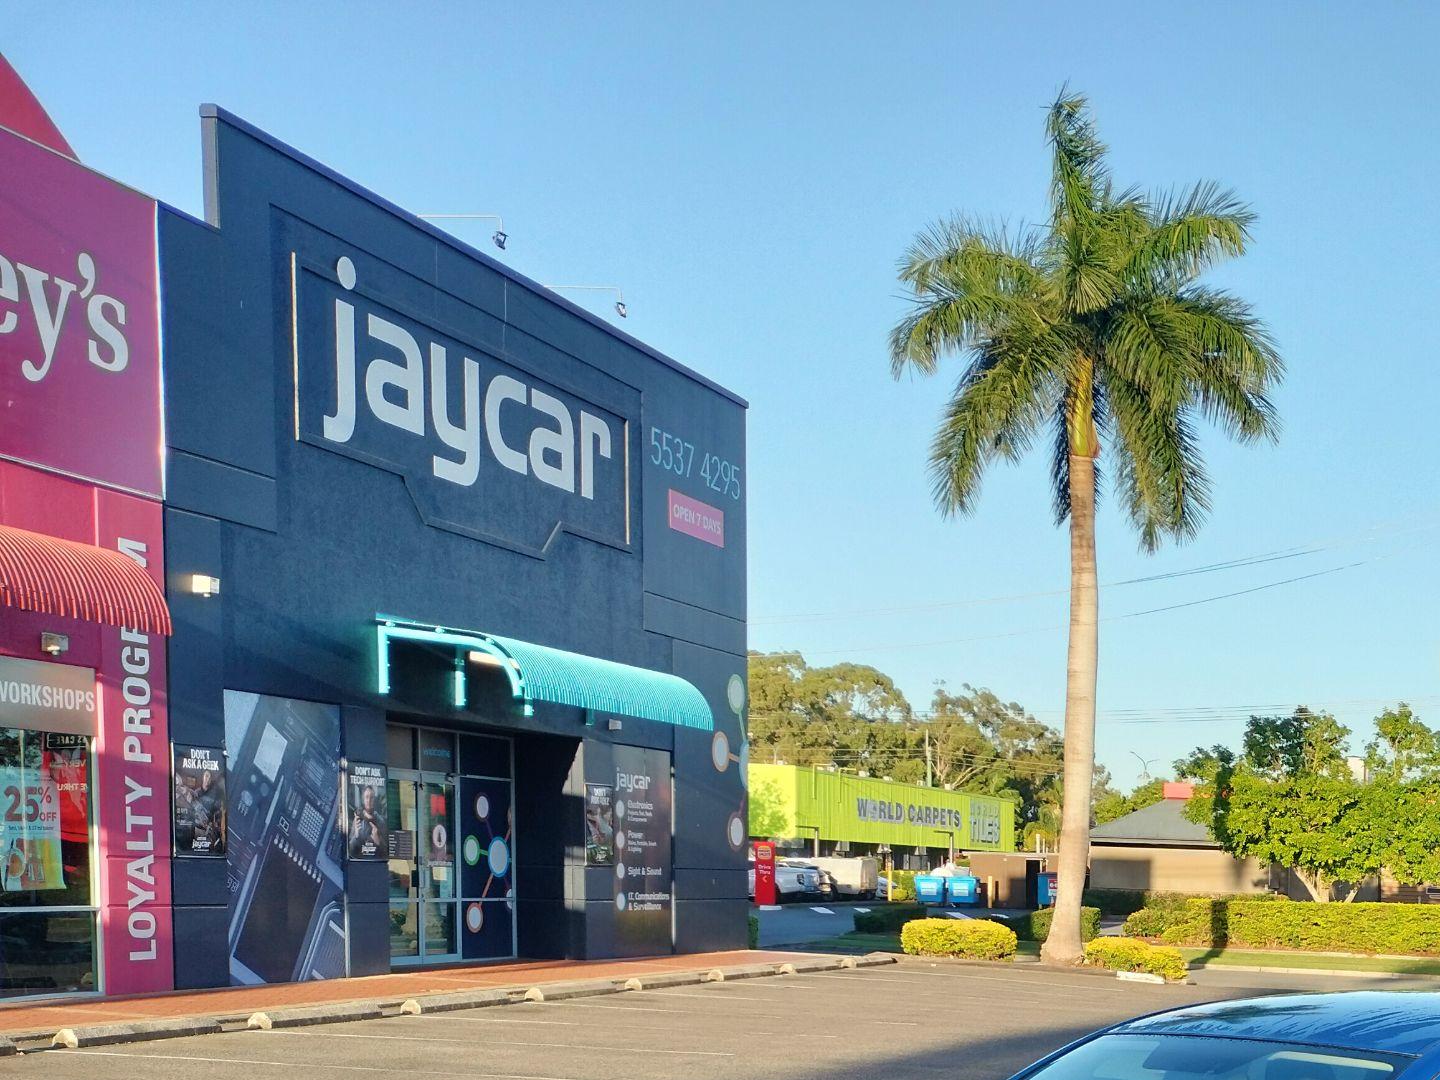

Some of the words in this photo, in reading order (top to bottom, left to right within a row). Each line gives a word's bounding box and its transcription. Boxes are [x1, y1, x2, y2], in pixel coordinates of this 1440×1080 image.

[322, 255, 612, 500] jaycar
[651, 426, 695, 478] 5537
[700, 452, 740, 500] 4295
[673, 503, 695, 525] OPEN
[696, 513, 701, 526] 7
[703, 515, 721, 535] DAYS
[182, 758, 196, 769] ASK
[190, 748, 210, 760] DON'T
[615, 766, 651, 793] jaycar
[908, 804, 961, 830] CARPETS
[124, 775, 157, 962] LOYALTY
